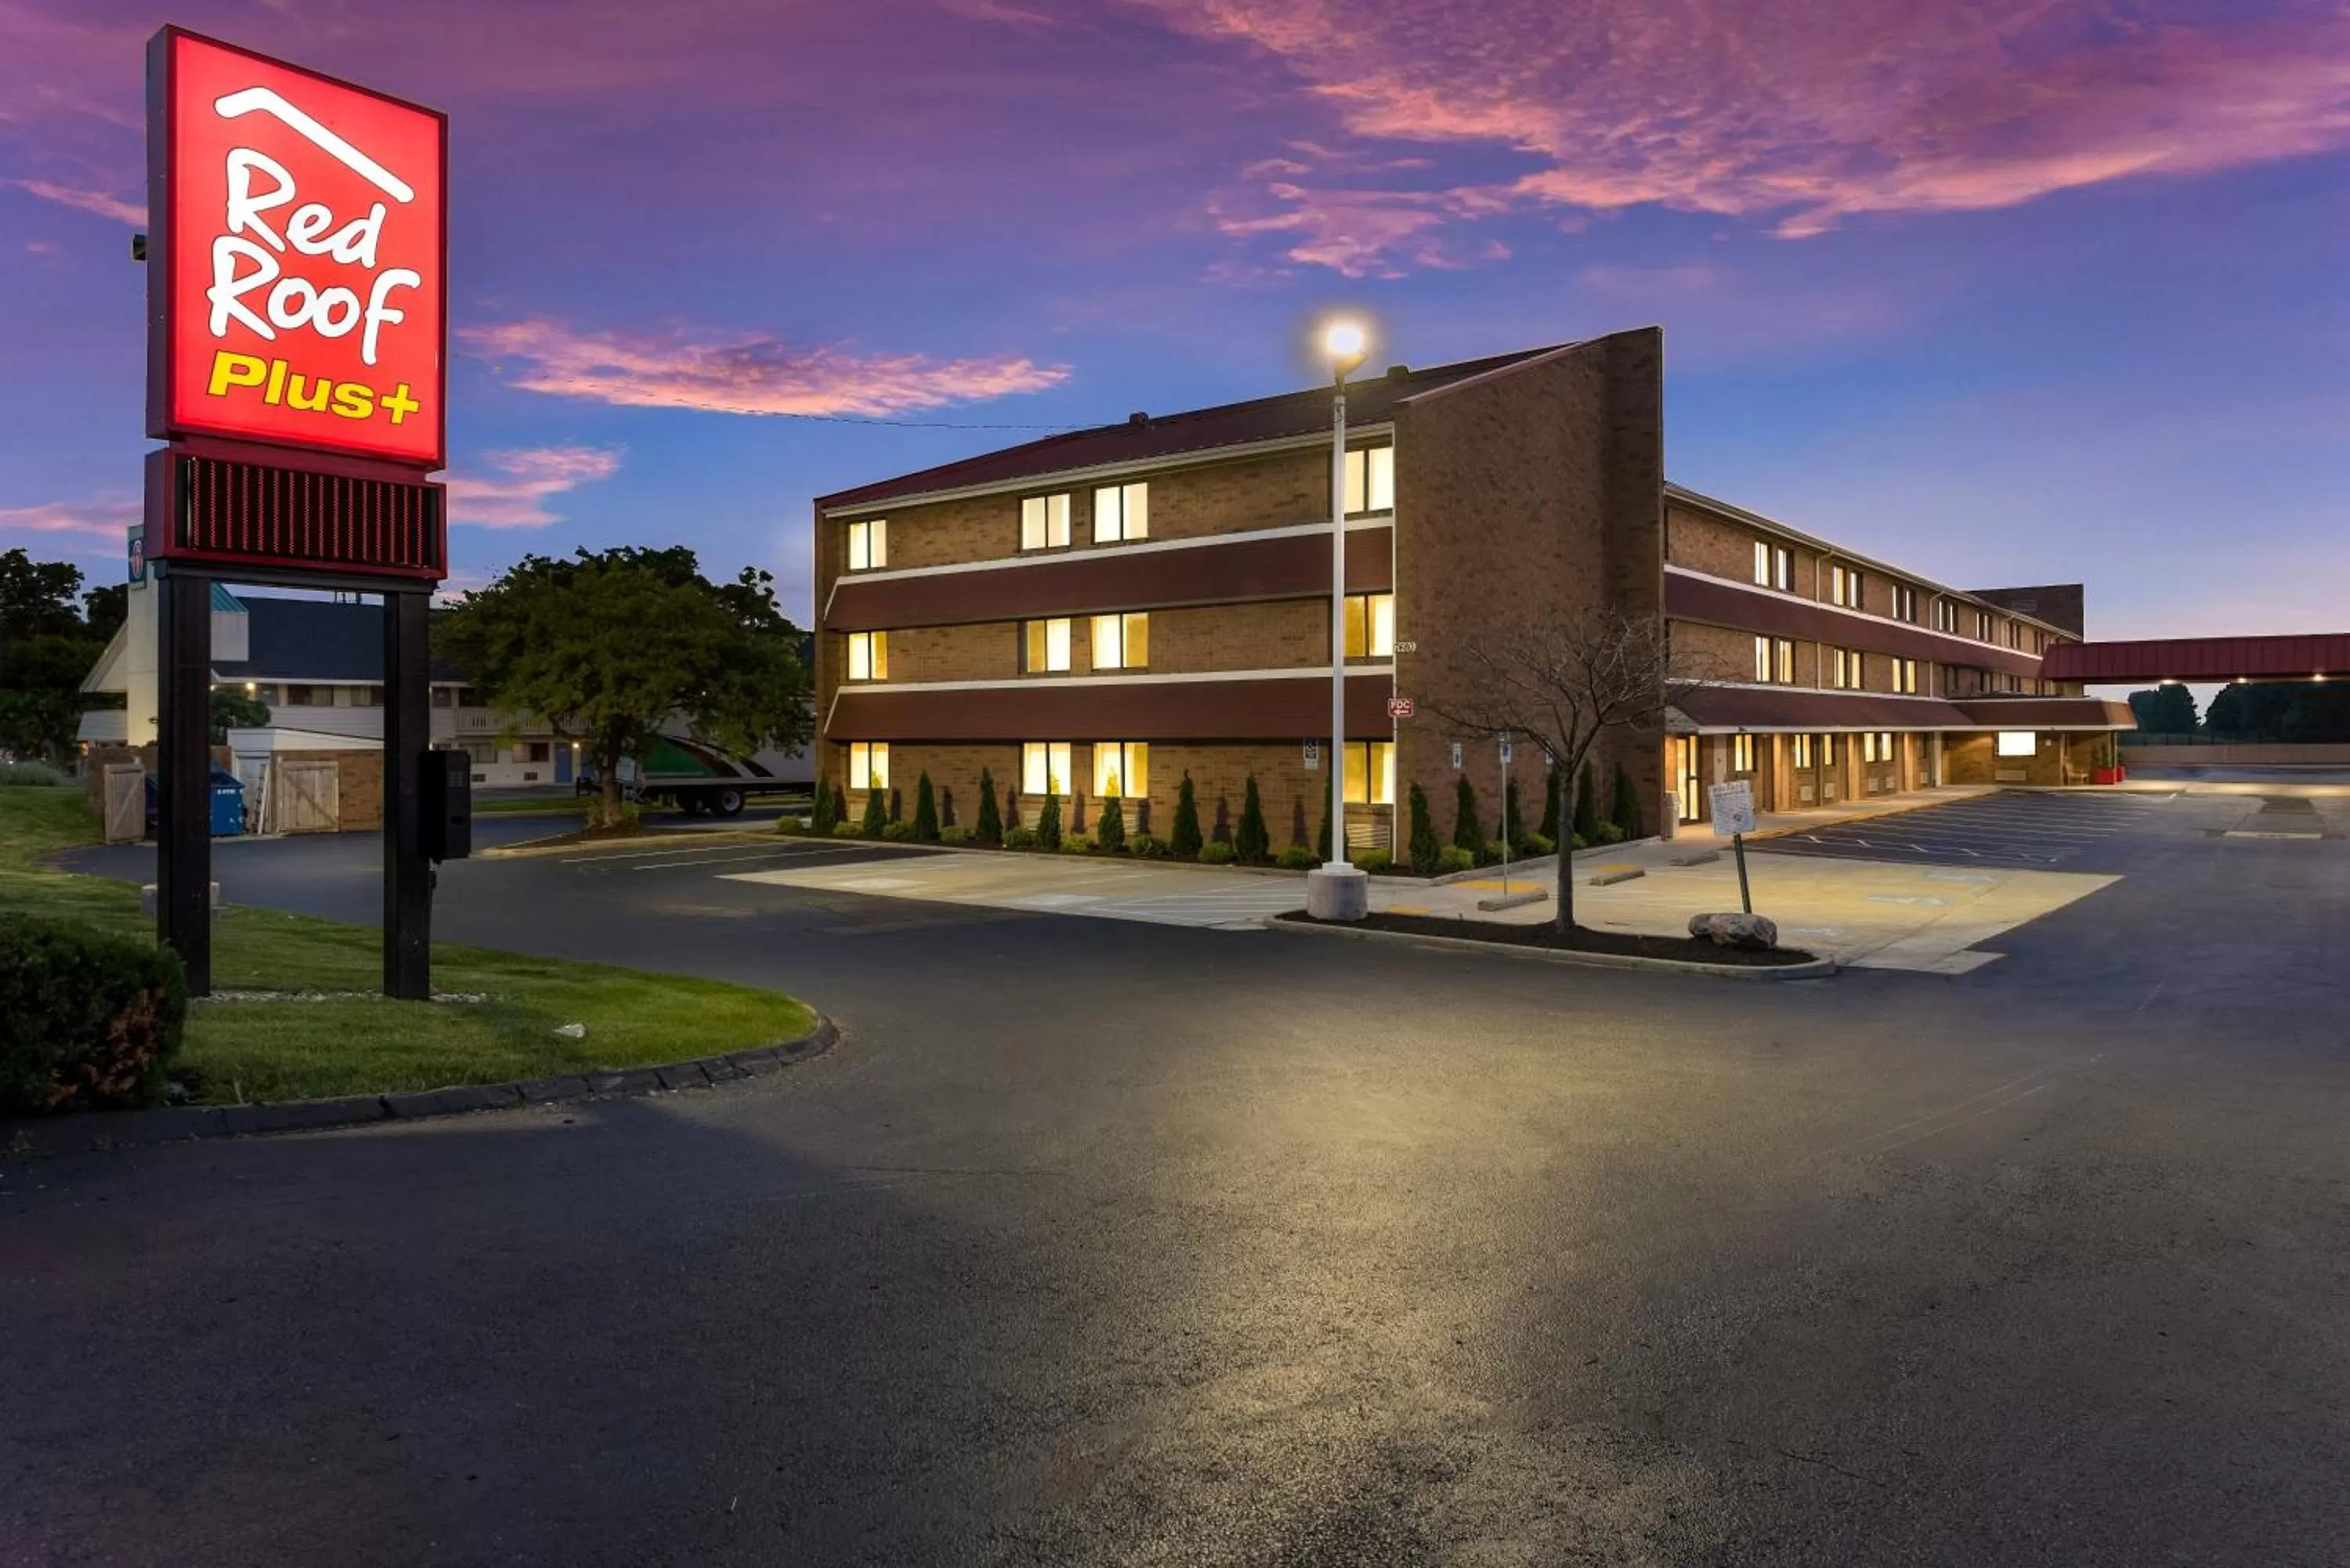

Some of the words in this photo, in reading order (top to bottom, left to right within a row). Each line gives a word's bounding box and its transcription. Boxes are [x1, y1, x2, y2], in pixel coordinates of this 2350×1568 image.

[226, 147, 387, 269] Red
[206, 235, 421, 366] Roof
[208, 351, 420, 424] Plus+
[1390, 699, 1411, 709] FDC
